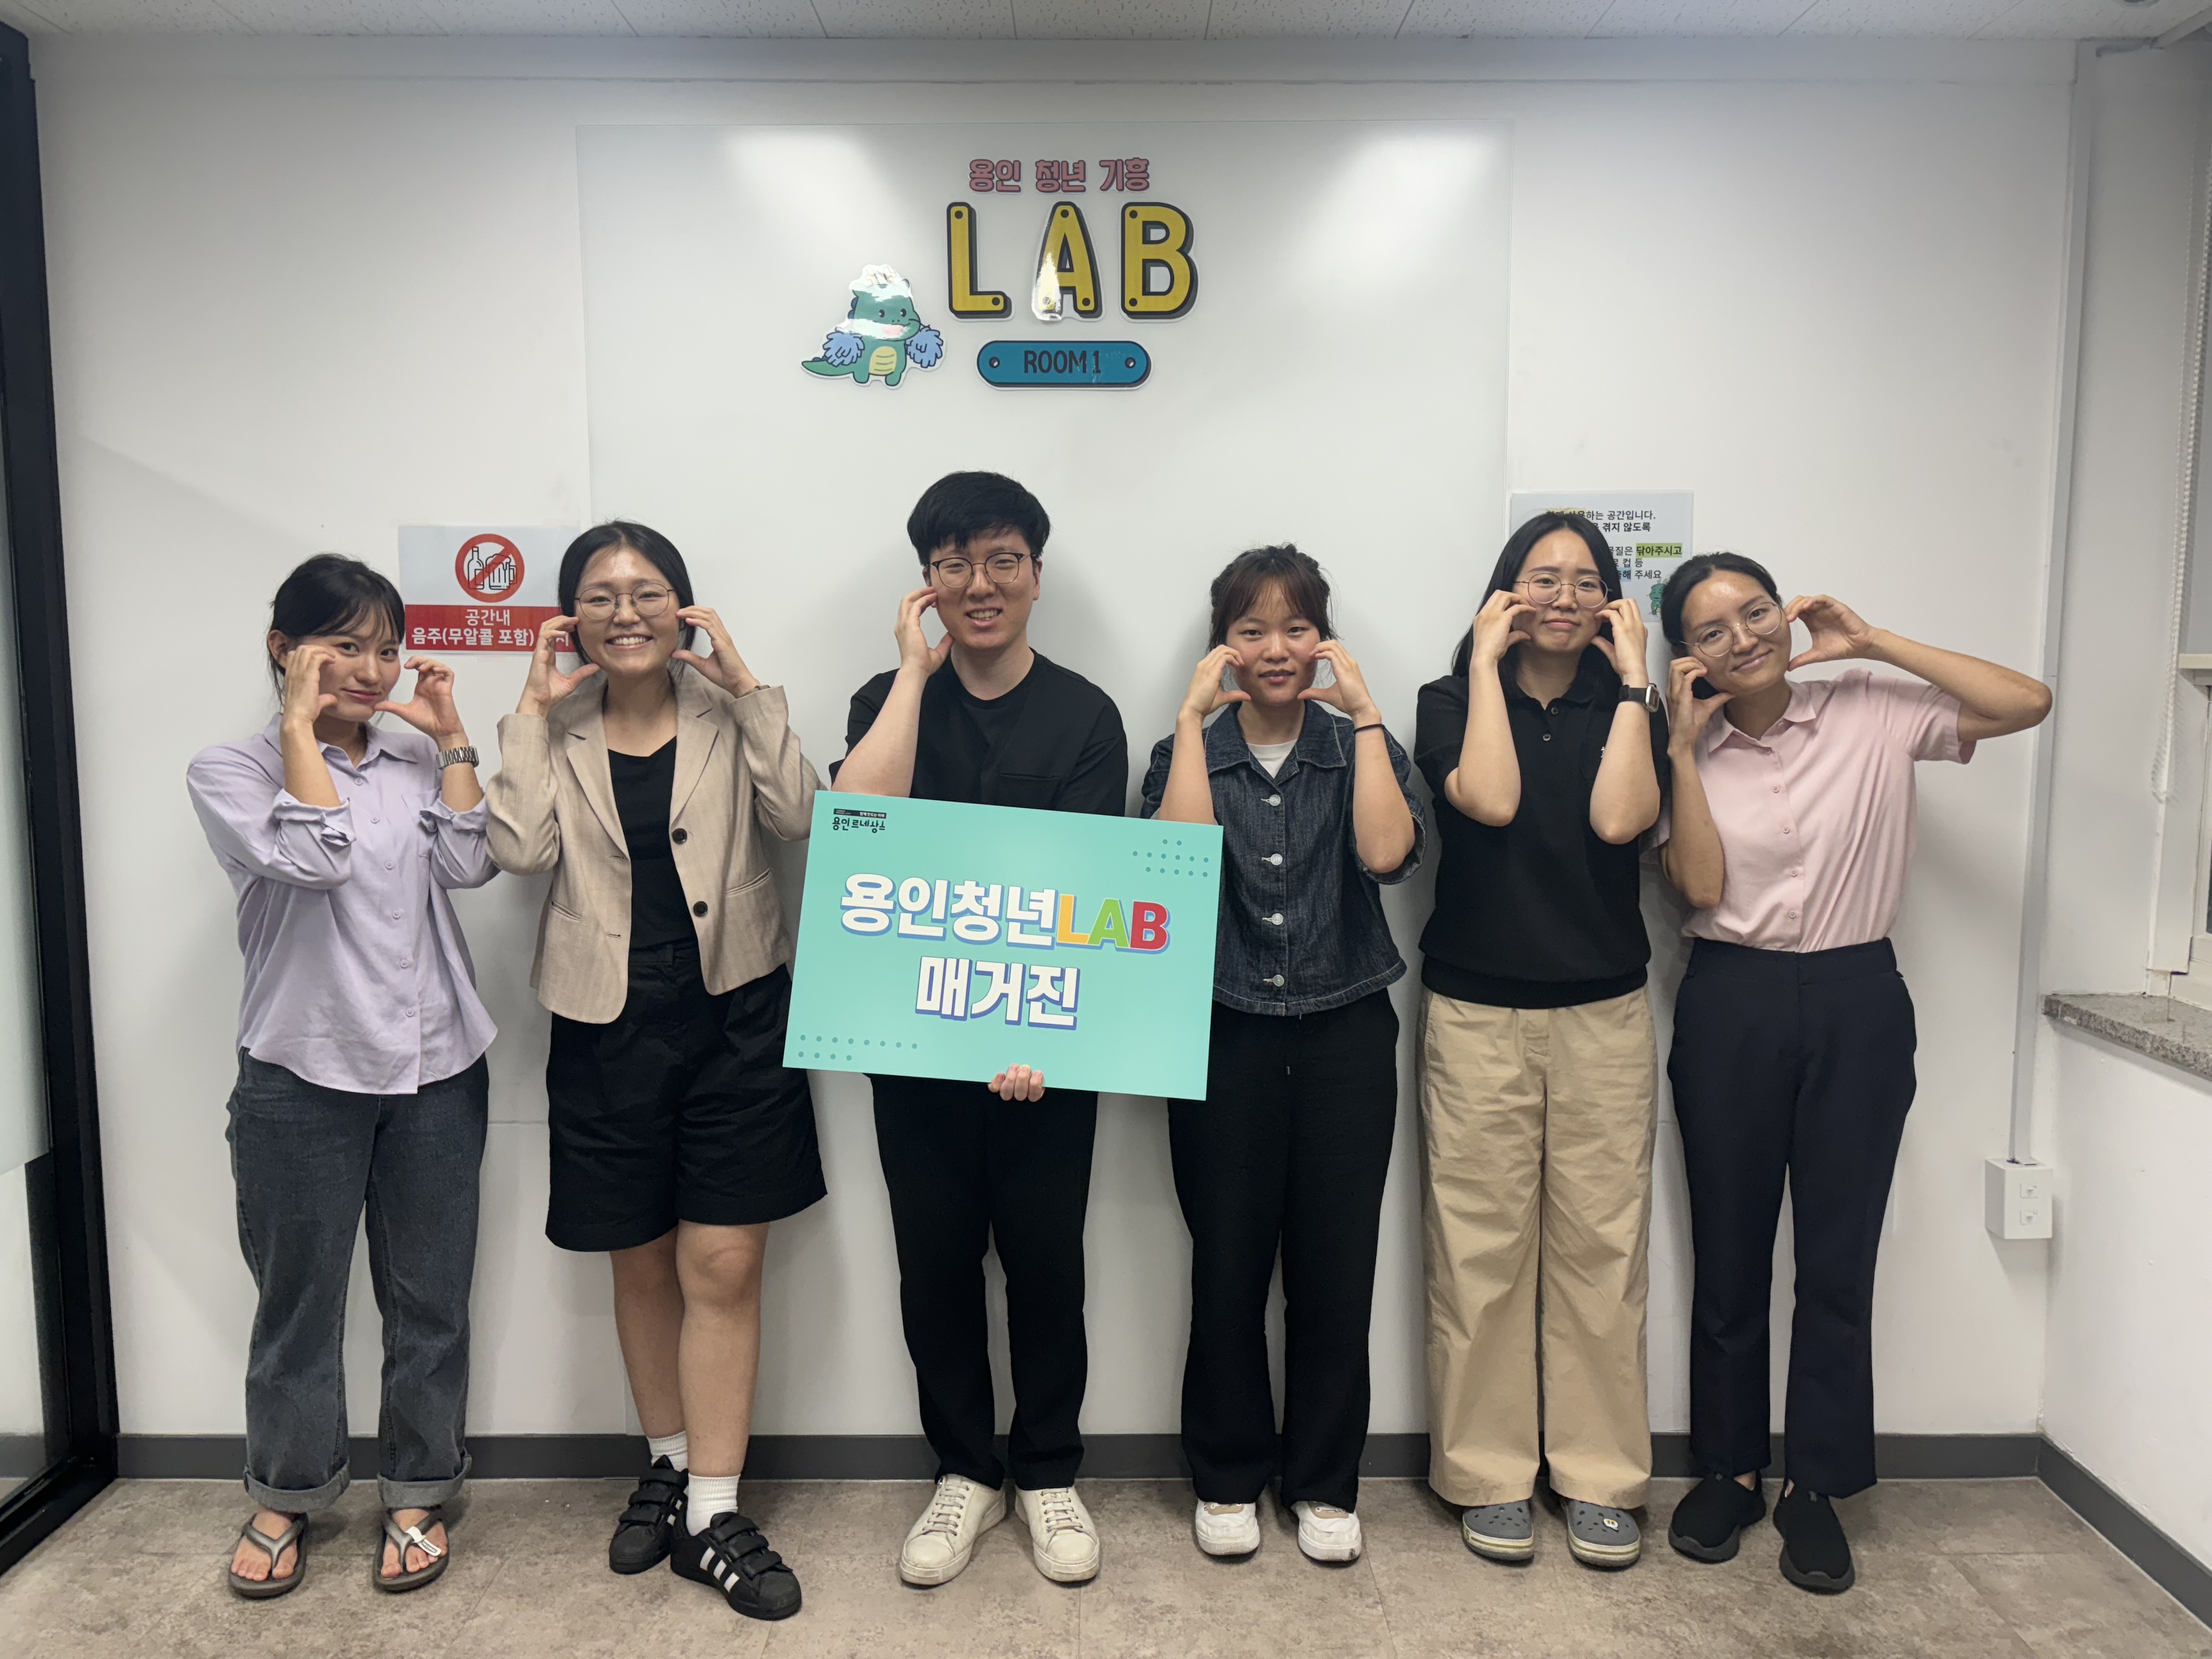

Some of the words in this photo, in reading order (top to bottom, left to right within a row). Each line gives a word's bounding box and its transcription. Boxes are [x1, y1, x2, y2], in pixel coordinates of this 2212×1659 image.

[969, 158, 1022, 193] 용인
[1035, 159, 1086, 193] 청년
[1099, 157, 1150, 193] 기흥
[946, 201, 1199, 319] LAB
[1607, 510, 1656, 521] 공간입니다.
[1602, 522, 1620, 532] 겪지
[1623, 522, 1651, 532] 않도록
[1636, 545, 1683, 556] 닦아주시고
[1622, 558, 1632, 568] 컵
[1634, 558, 1644, 568] 등
[1634, 569, 1662, 580] 주세요
[465, 608, 511, 627] 공간내
[411, 627, 494, 646] 음주(무알콜
[498, 628, 535, 647] 포함)
[915, 955, 1081, 1030] 매거진
